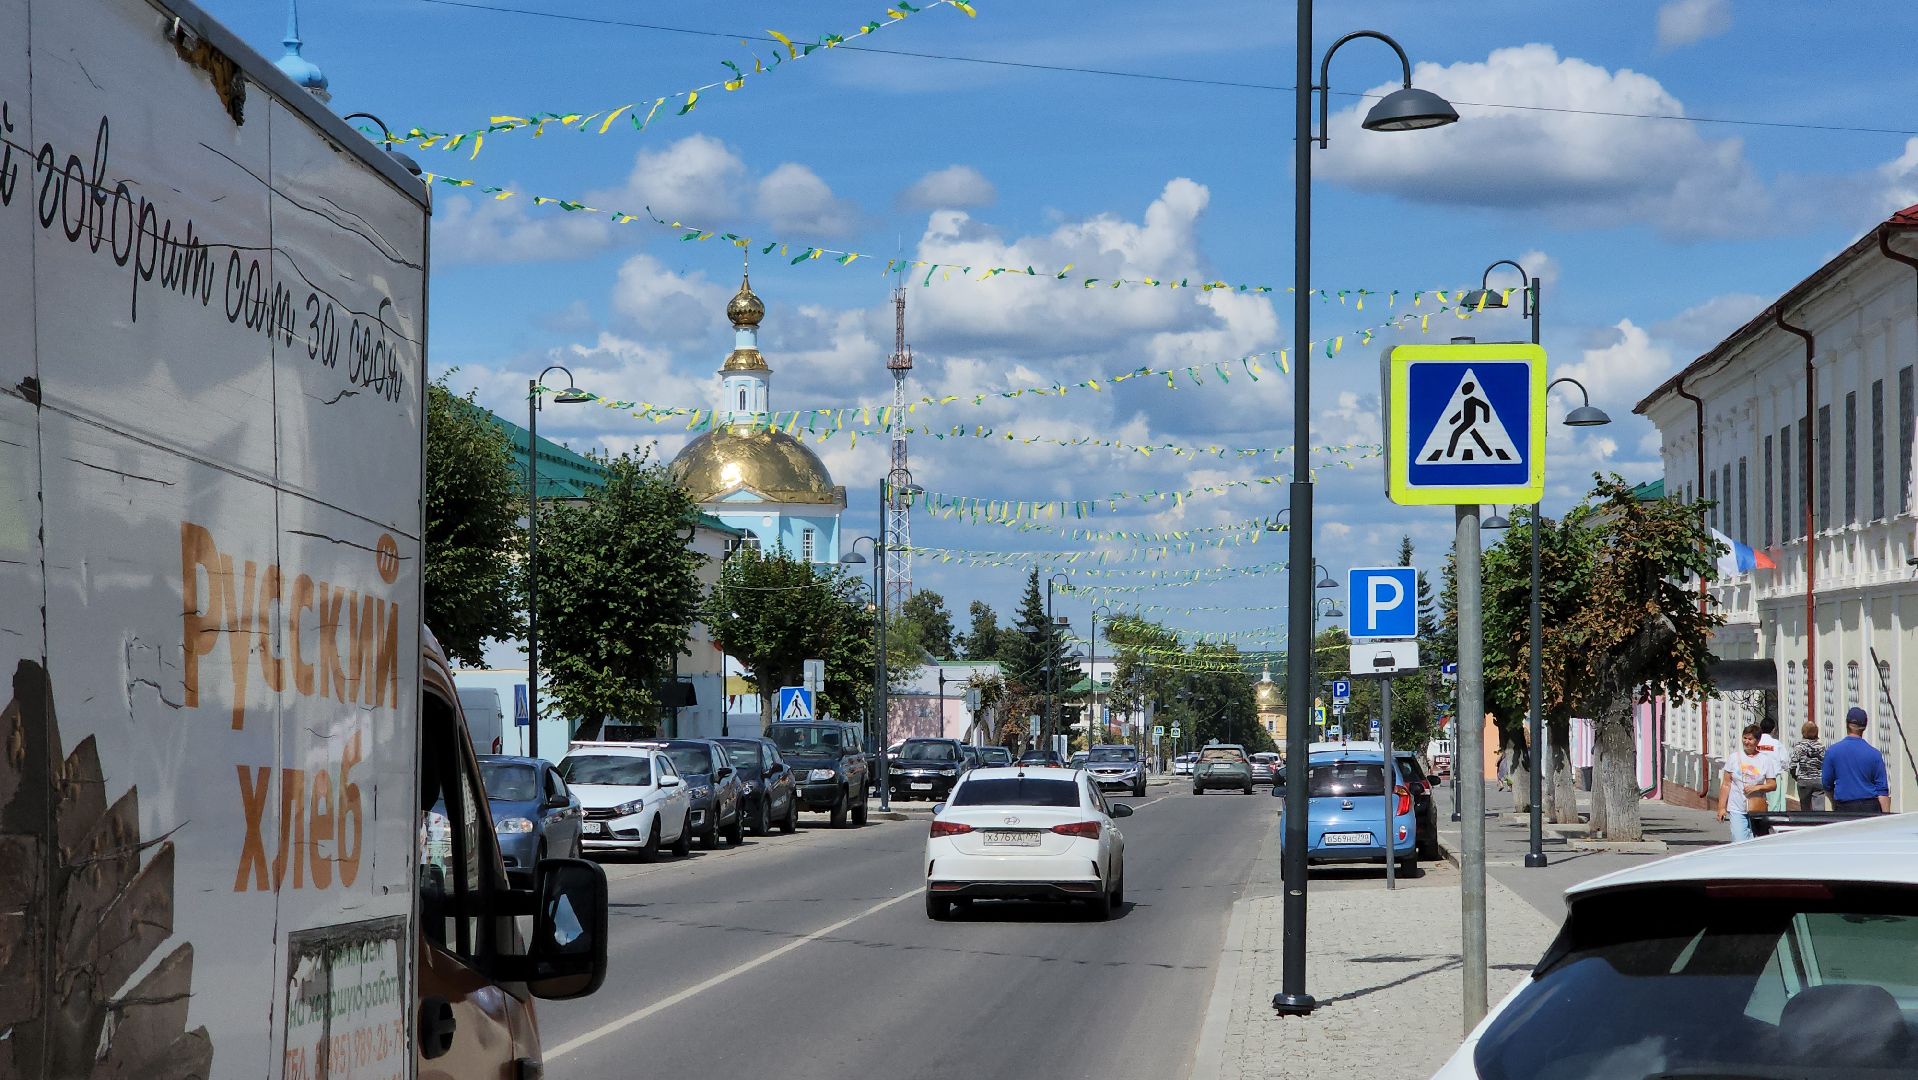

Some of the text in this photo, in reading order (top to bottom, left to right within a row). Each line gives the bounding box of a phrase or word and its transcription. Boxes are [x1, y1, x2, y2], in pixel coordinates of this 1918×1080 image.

[37, 115, 215, 323] говорит
[226, 250, 296, 348] сам
[306, 292, 340, 369] за
[349, 296, 403, 403] себя
[180, 520, 399, 731] Русский
[1367, 575, 1404, 630] P
[1336, 682, 1346, 696] P
[234, 728, 362, 895] хлеб
